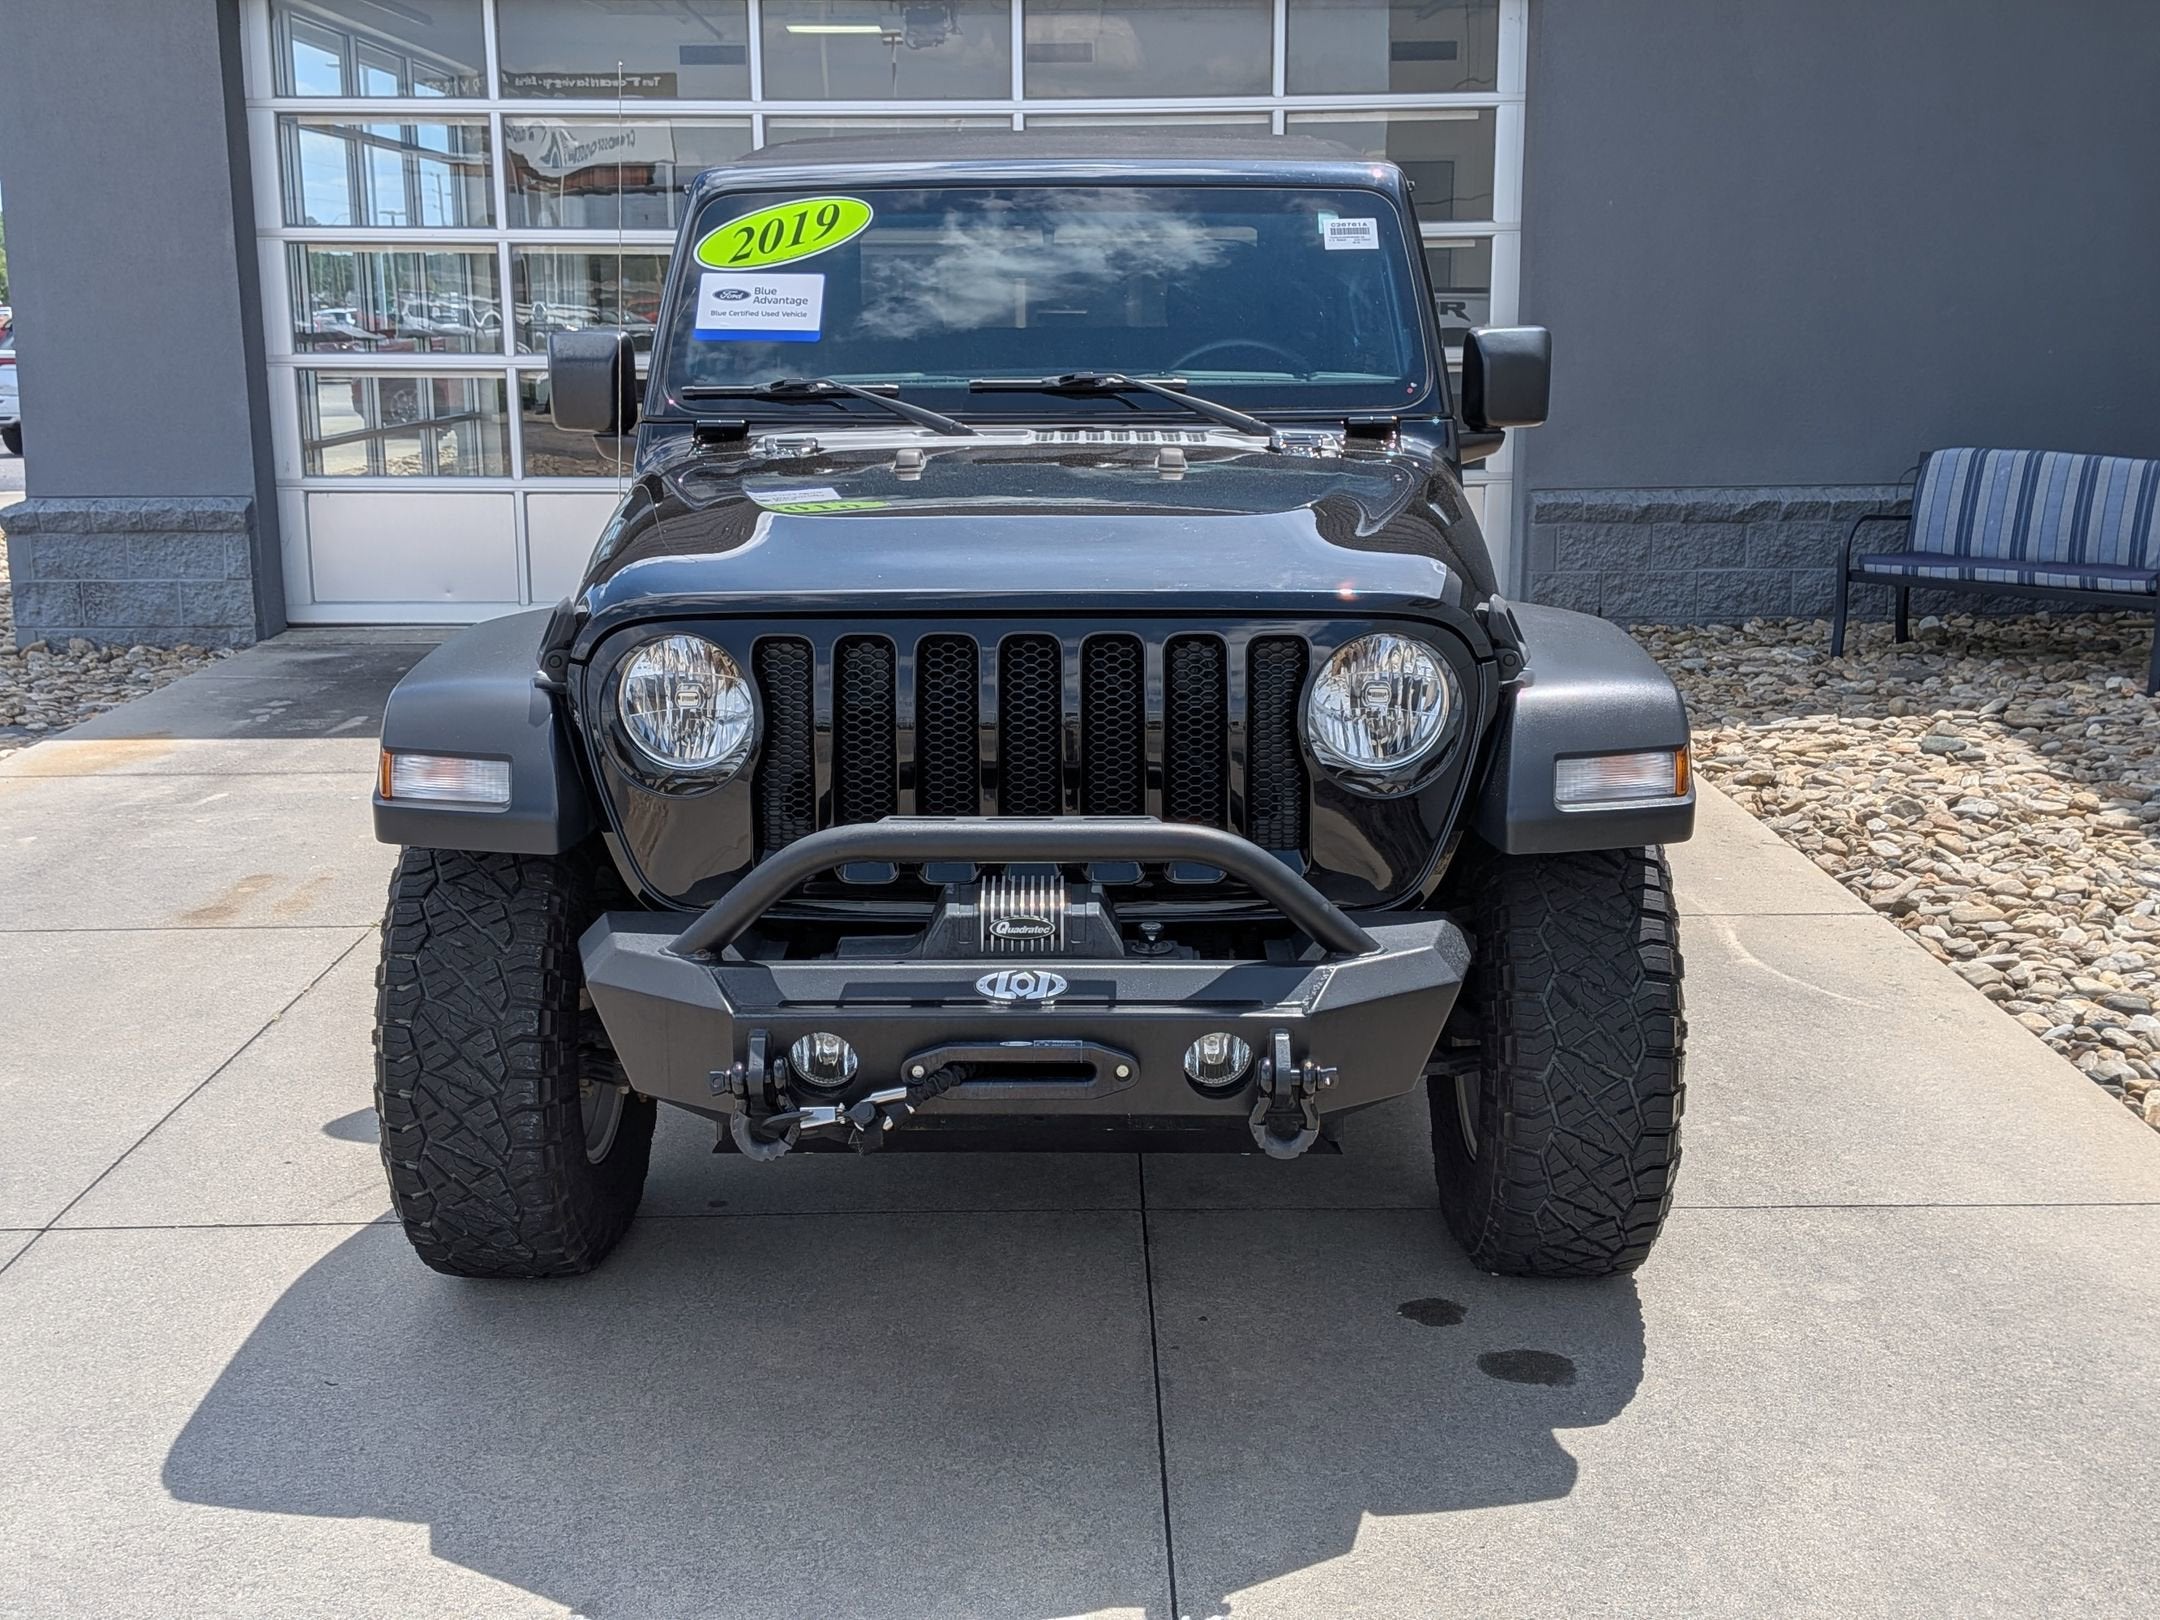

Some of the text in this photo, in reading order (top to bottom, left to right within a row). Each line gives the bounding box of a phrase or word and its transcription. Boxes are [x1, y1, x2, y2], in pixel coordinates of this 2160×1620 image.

[728, 204, 840, 263] 2019
[754, 287, 777, 296] Blue
[753, 296, 809, 306] Advantage
[781, 310, 807, 318] Vehicle
[996, 922, 1050, 934] Quadratec
